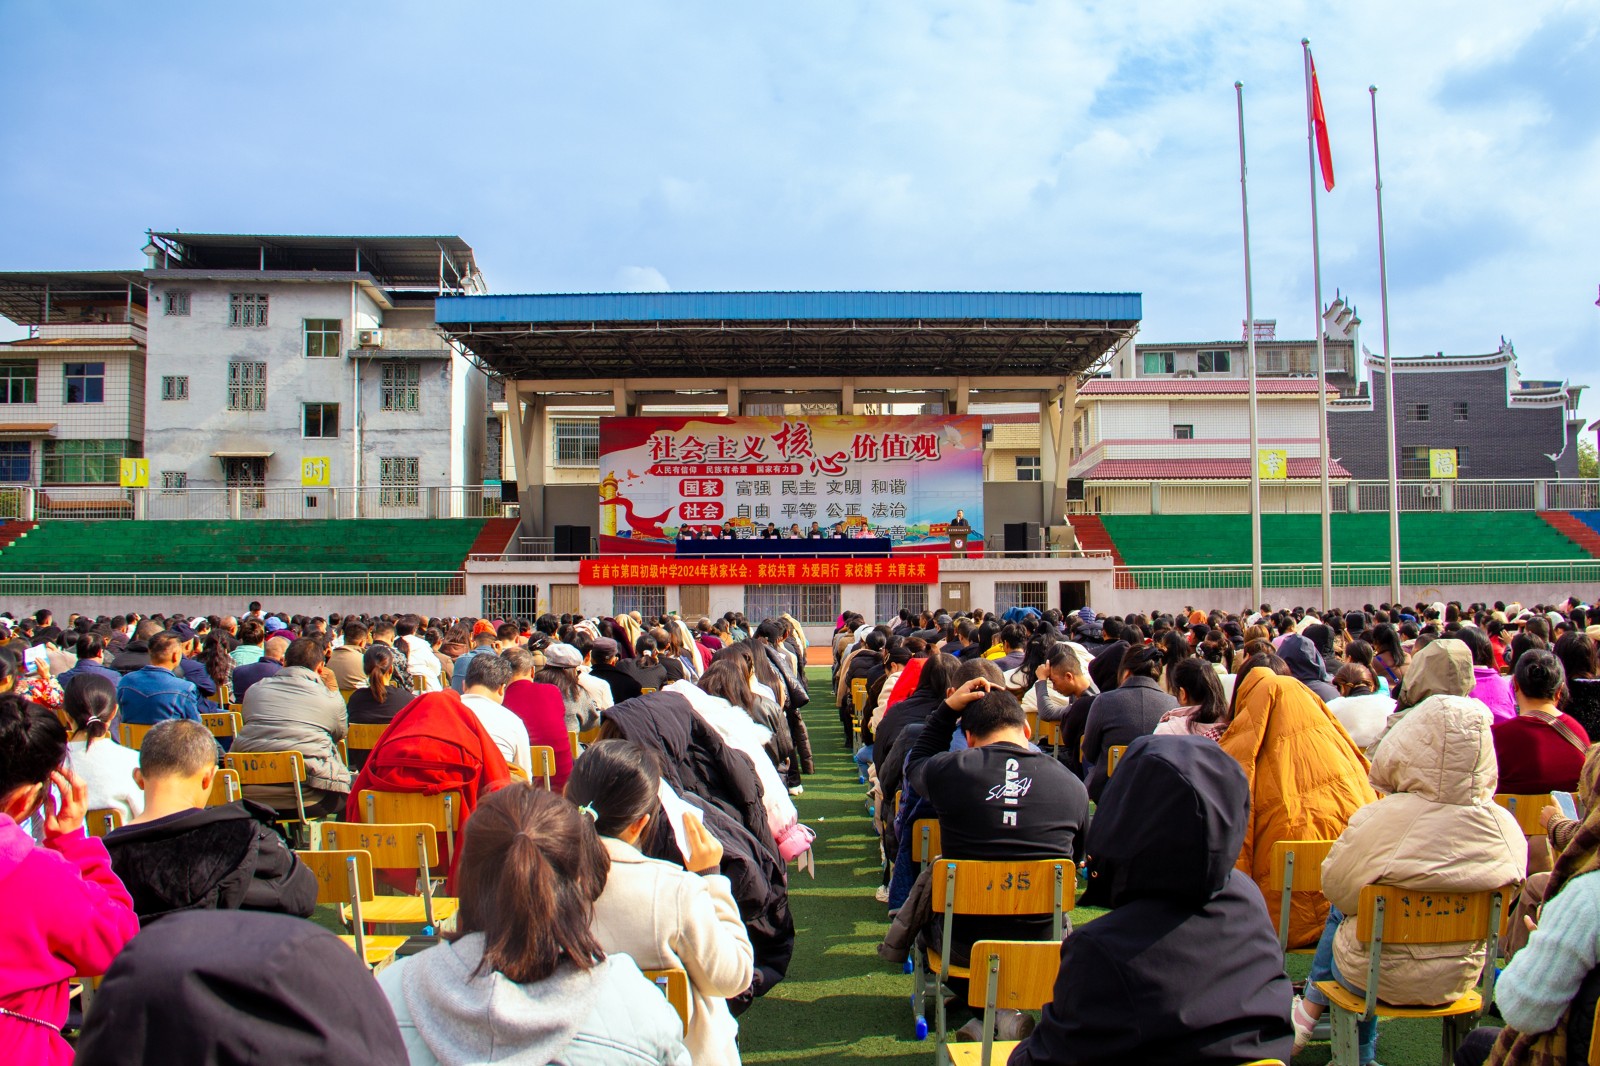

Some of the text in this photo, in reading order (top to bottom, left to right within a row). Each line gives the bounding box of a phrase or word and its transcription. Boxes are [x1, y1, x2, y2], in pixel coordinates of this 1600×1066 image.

[124, 461, 145, 483] 小
[305, 459, 327, 482] 时
[655, 464, 798, 475] 人民有信仰 民族有希望 国家有力量
[1263, 451, 1284, 477] 幸
[1436, 451, 1454, 475] 福
[683, 480, 719, 496] 国家
[735, 478, 907, 496] 富强 民主 文明 和谐
[683, 503, 719, 519] 社会
[736, 501, 907, 519] 自由 平等 公正 法治
[758, 563, 796, 578] 家校共育
[801, 562, 840, 578] 为爱同行
[844, 562, 883, 578] 家校携手
[888, 562, 926, 578] 共育未来
